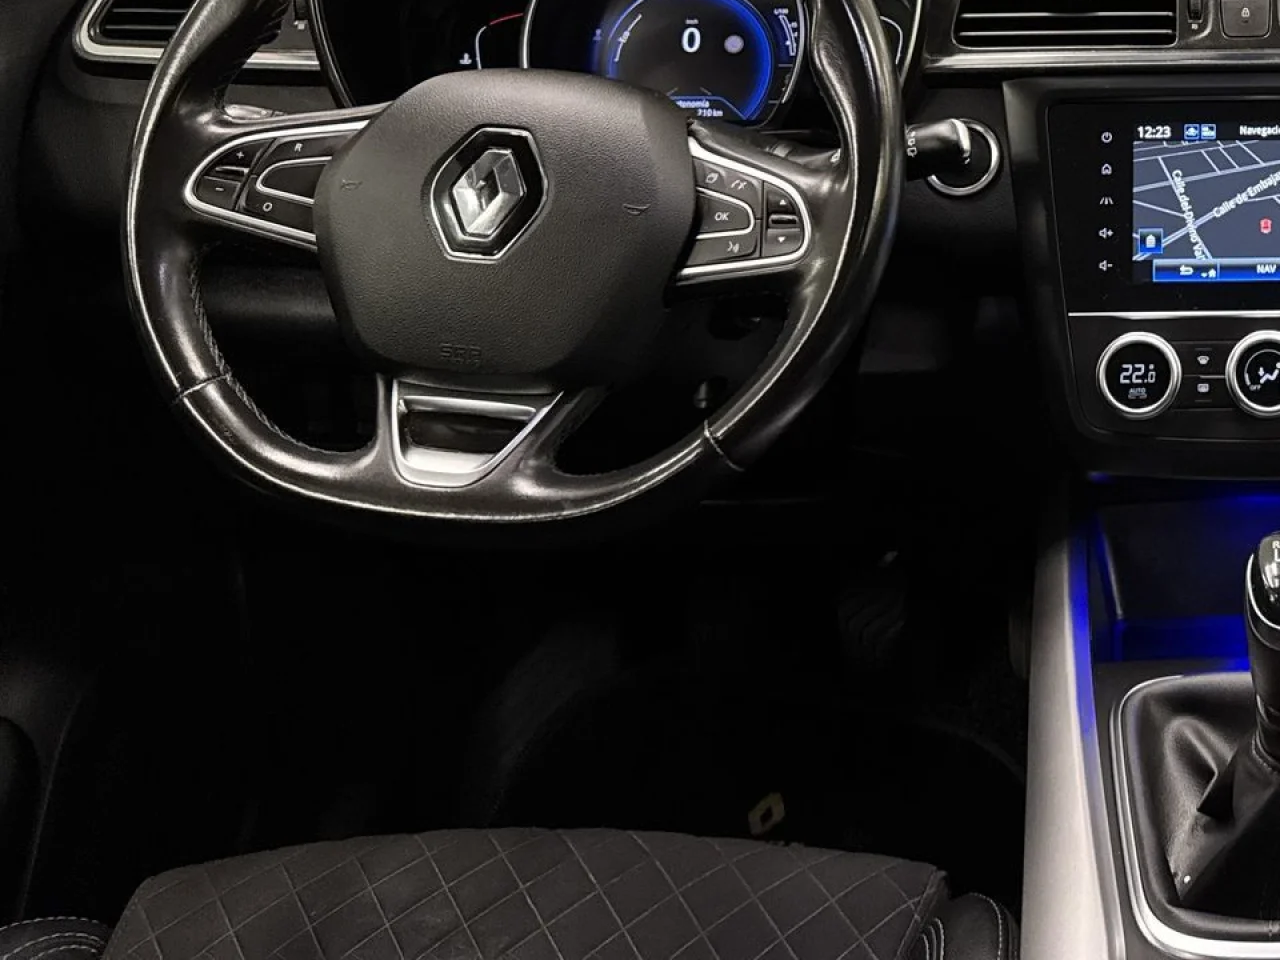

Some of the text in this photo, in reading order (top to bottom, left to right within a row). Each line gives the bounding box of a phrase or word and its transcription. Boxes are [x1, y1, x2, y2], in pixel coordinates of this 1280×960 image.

[682, 27, 701, 53] 0
[1137, 125, 1172, 139] 12:23
[1212, 200, 1237, 218] Calle
[1235, 192, 1248, 205] de
[714, 211, 730, 221] OK
[1256, 264, 1277, 275] NAV
[1272, 540, 1280, 549] R
